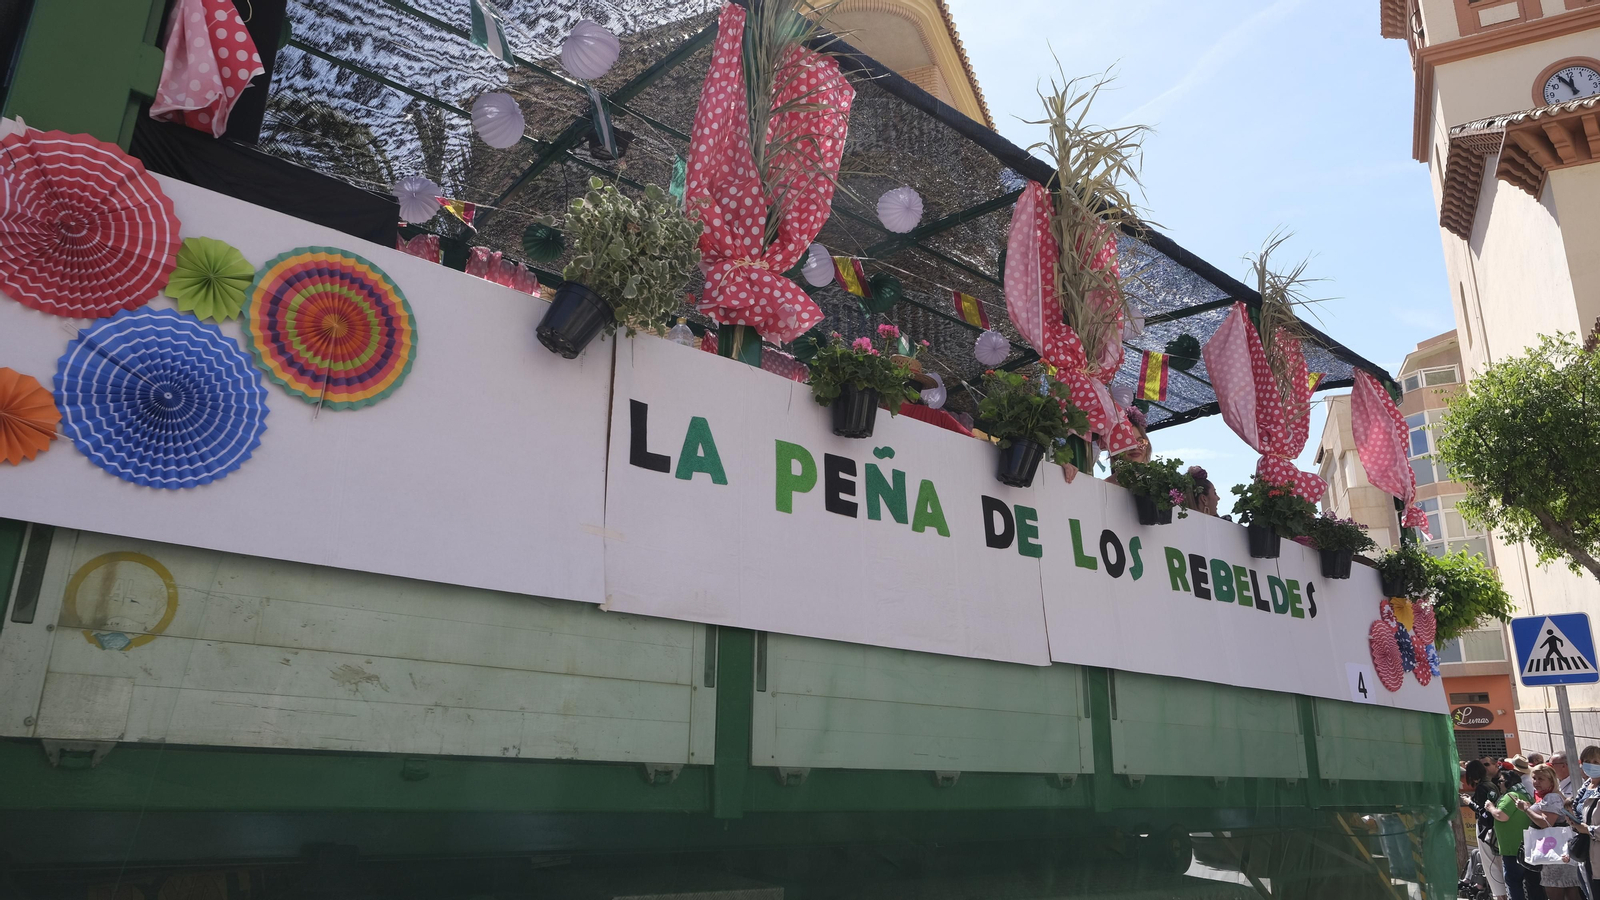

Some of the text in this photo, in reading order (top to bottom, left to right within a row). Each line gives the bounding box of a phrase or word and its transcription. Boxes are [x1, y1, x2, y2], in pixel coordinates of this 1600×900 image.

[629, 398, 1317, 619] LA PEÑA DE LOS REBELDES
[1358, 671, 1368, 699] 4
[1457, 706, 1490, 725] Lunas
